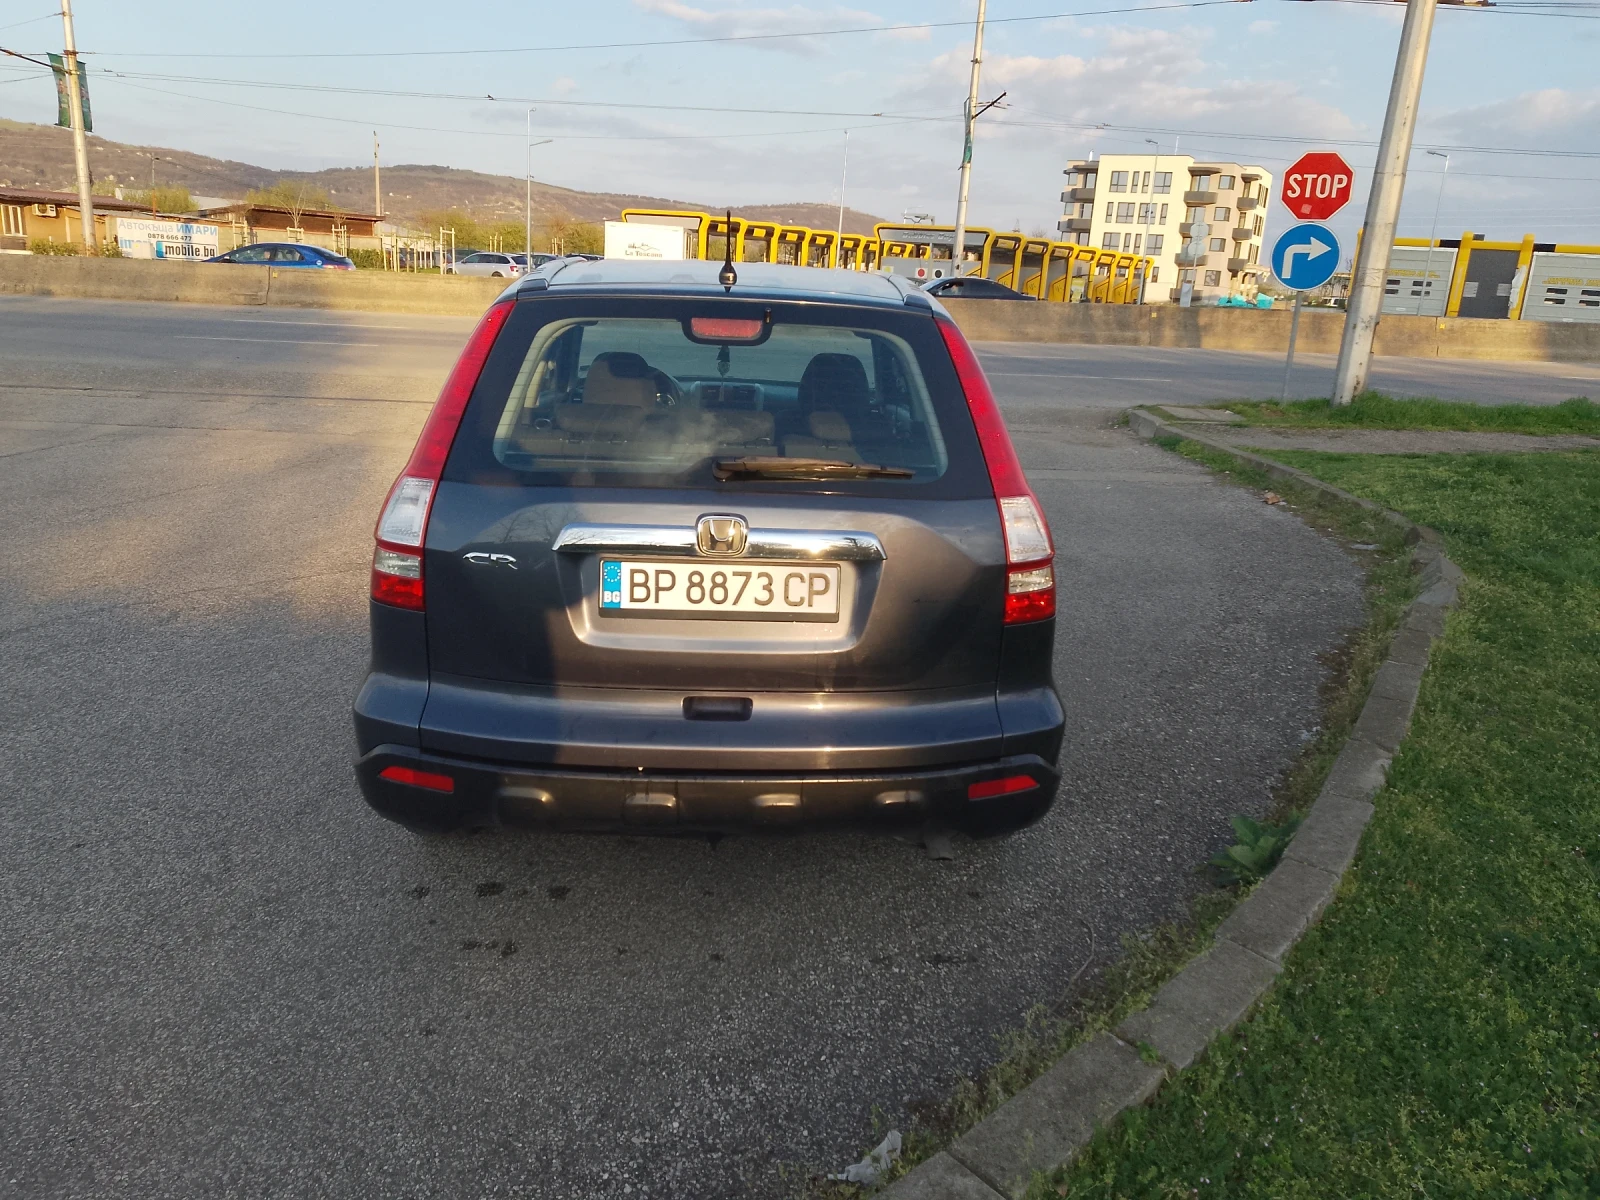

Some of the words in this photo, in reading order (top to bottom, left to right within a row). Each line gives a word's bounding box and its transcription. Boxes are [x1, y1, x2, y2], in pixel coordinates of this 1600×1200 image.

[1286, 173, 1348, 198] STOP
[176, 223, 217, 236] ИМАРИ
[164, 244, 215, 258] mobile.bg
[629, 568, 676, 604] BP
[686, 570, 775, 606] 8873
[783, 572, 831, 607] CP
[603, 590, 620, 603] BG
